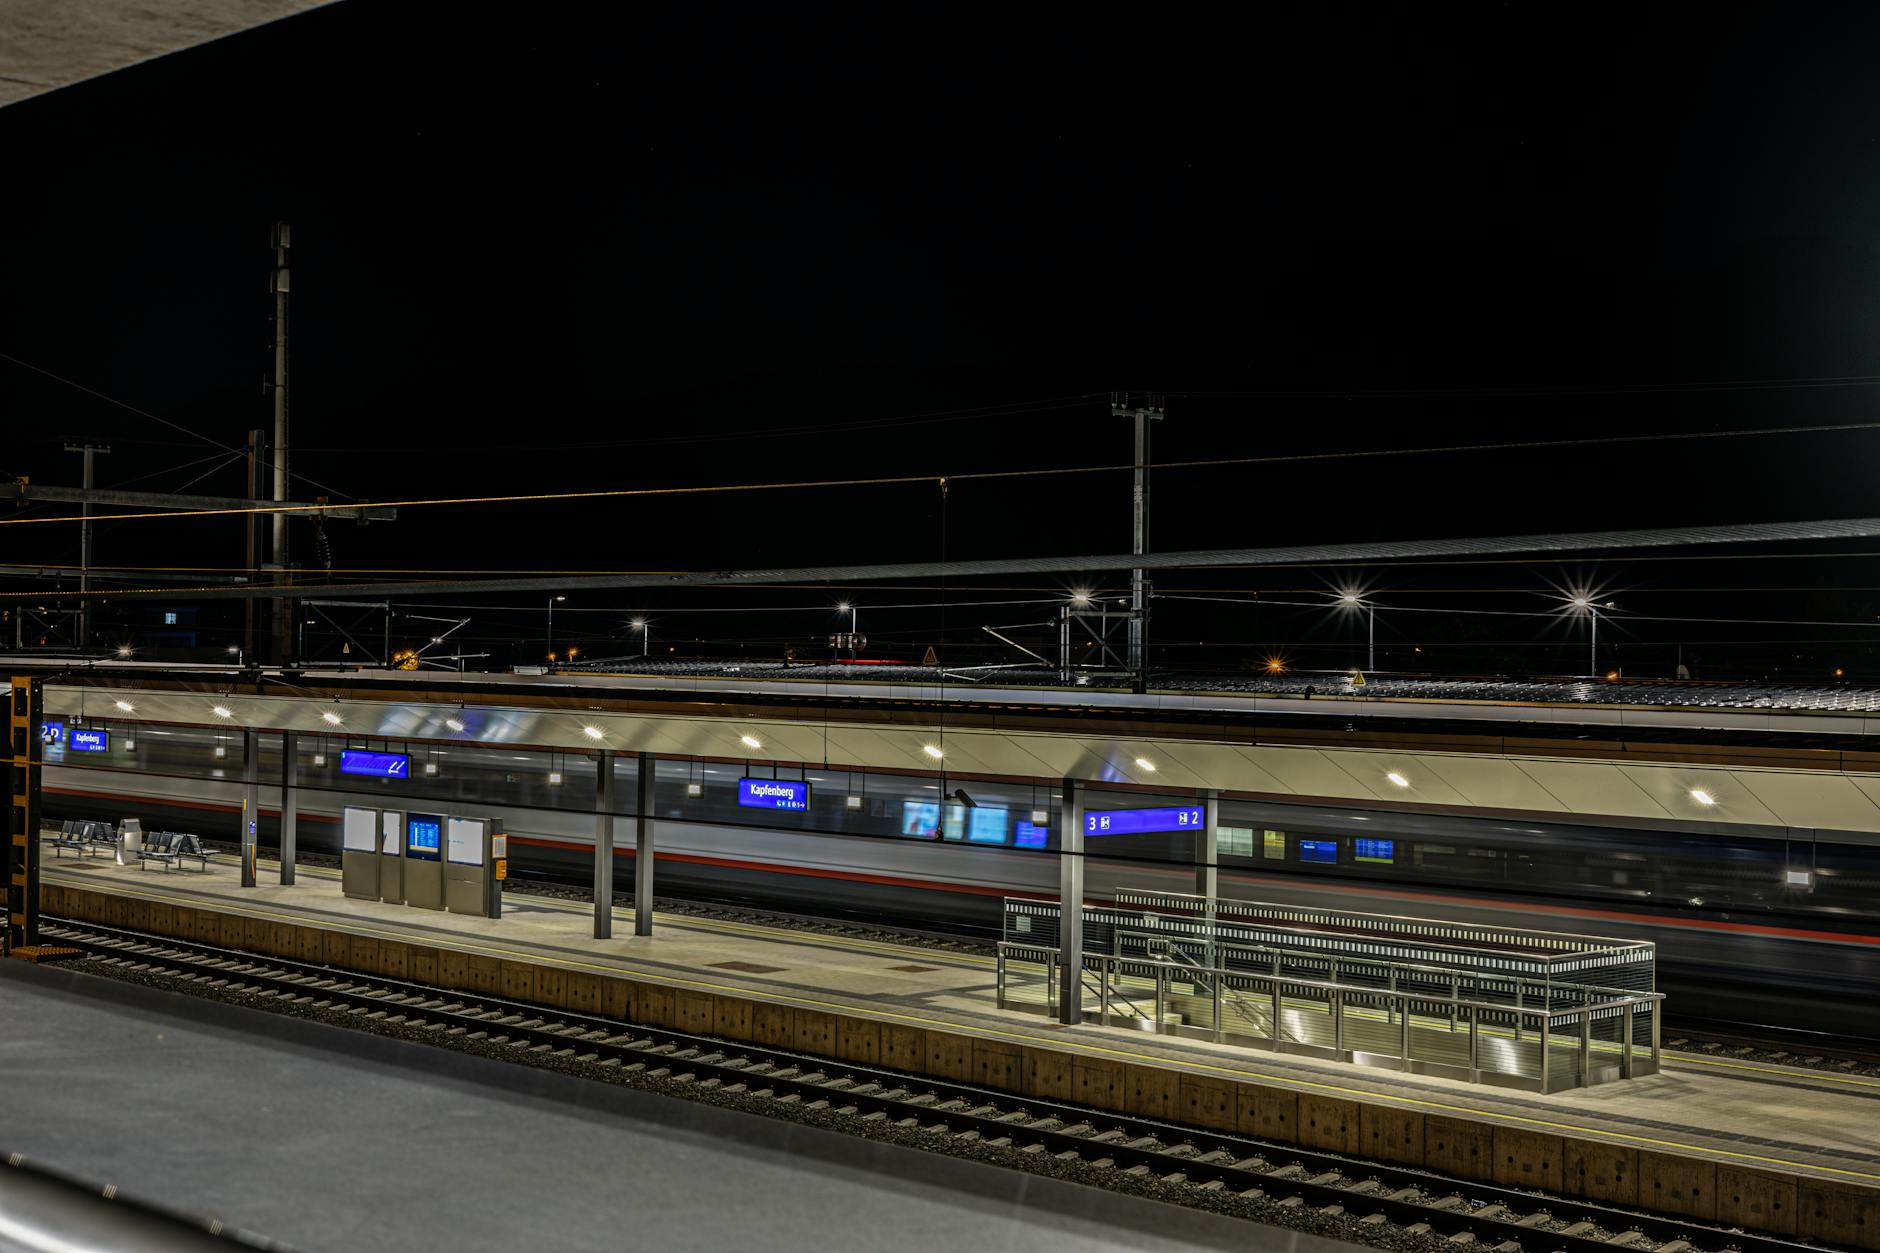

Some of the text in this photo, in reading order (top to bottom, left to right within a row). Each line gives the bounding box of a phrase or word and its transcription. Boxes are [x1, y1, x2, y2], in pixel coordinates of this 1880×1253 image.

[750, 784, 793, 799] Kapfenberg
[1089, 817, 1096, 830] 3
[1192, 811, 1198, 824] 2
